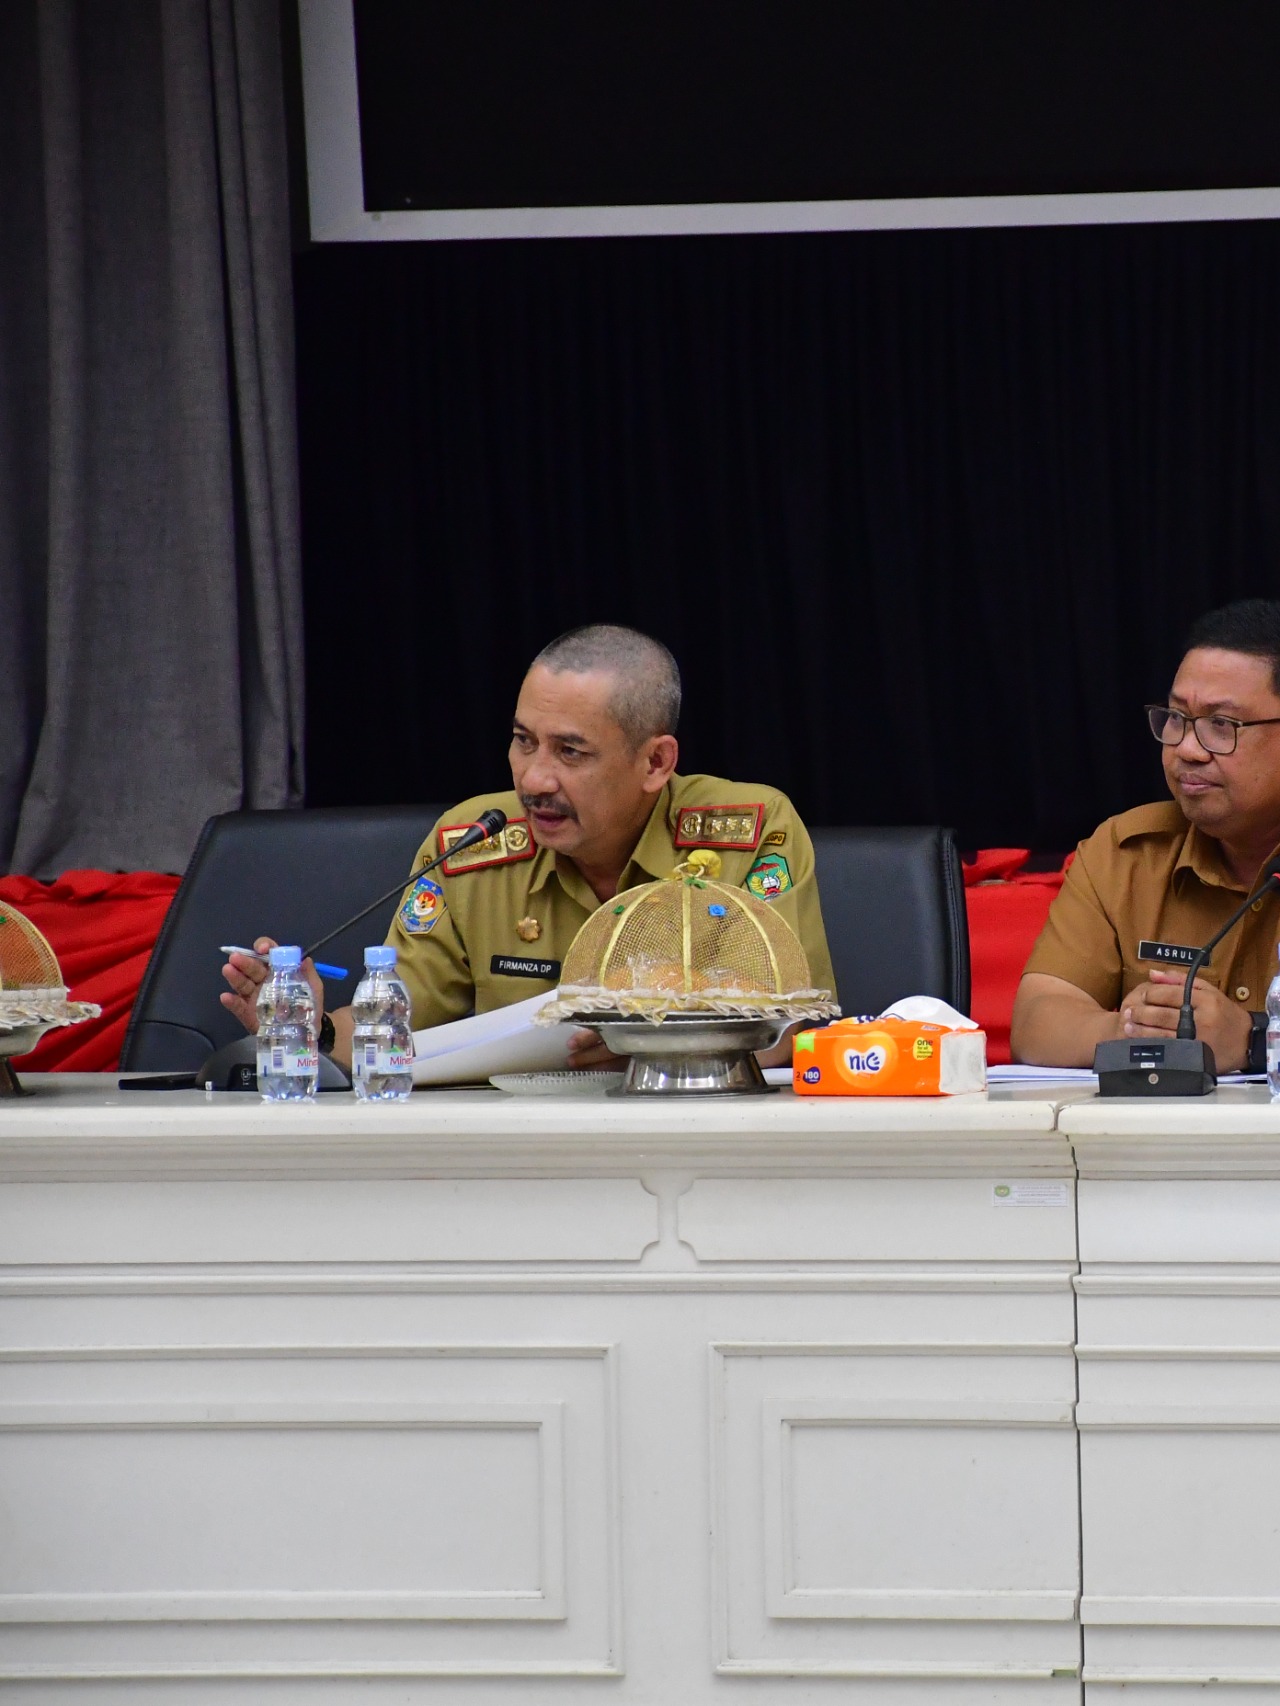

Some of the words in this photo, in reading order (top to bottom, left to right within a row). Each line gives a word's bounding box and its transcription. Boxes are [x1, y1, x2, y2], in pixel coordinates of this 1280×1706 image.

[1156, 947, 1193, 960] ASRUL
[498, 960, 539, 973] FIRMANZA
[540, 964, 552, 974] DP
[804, 1071, 820, 1080] 180
